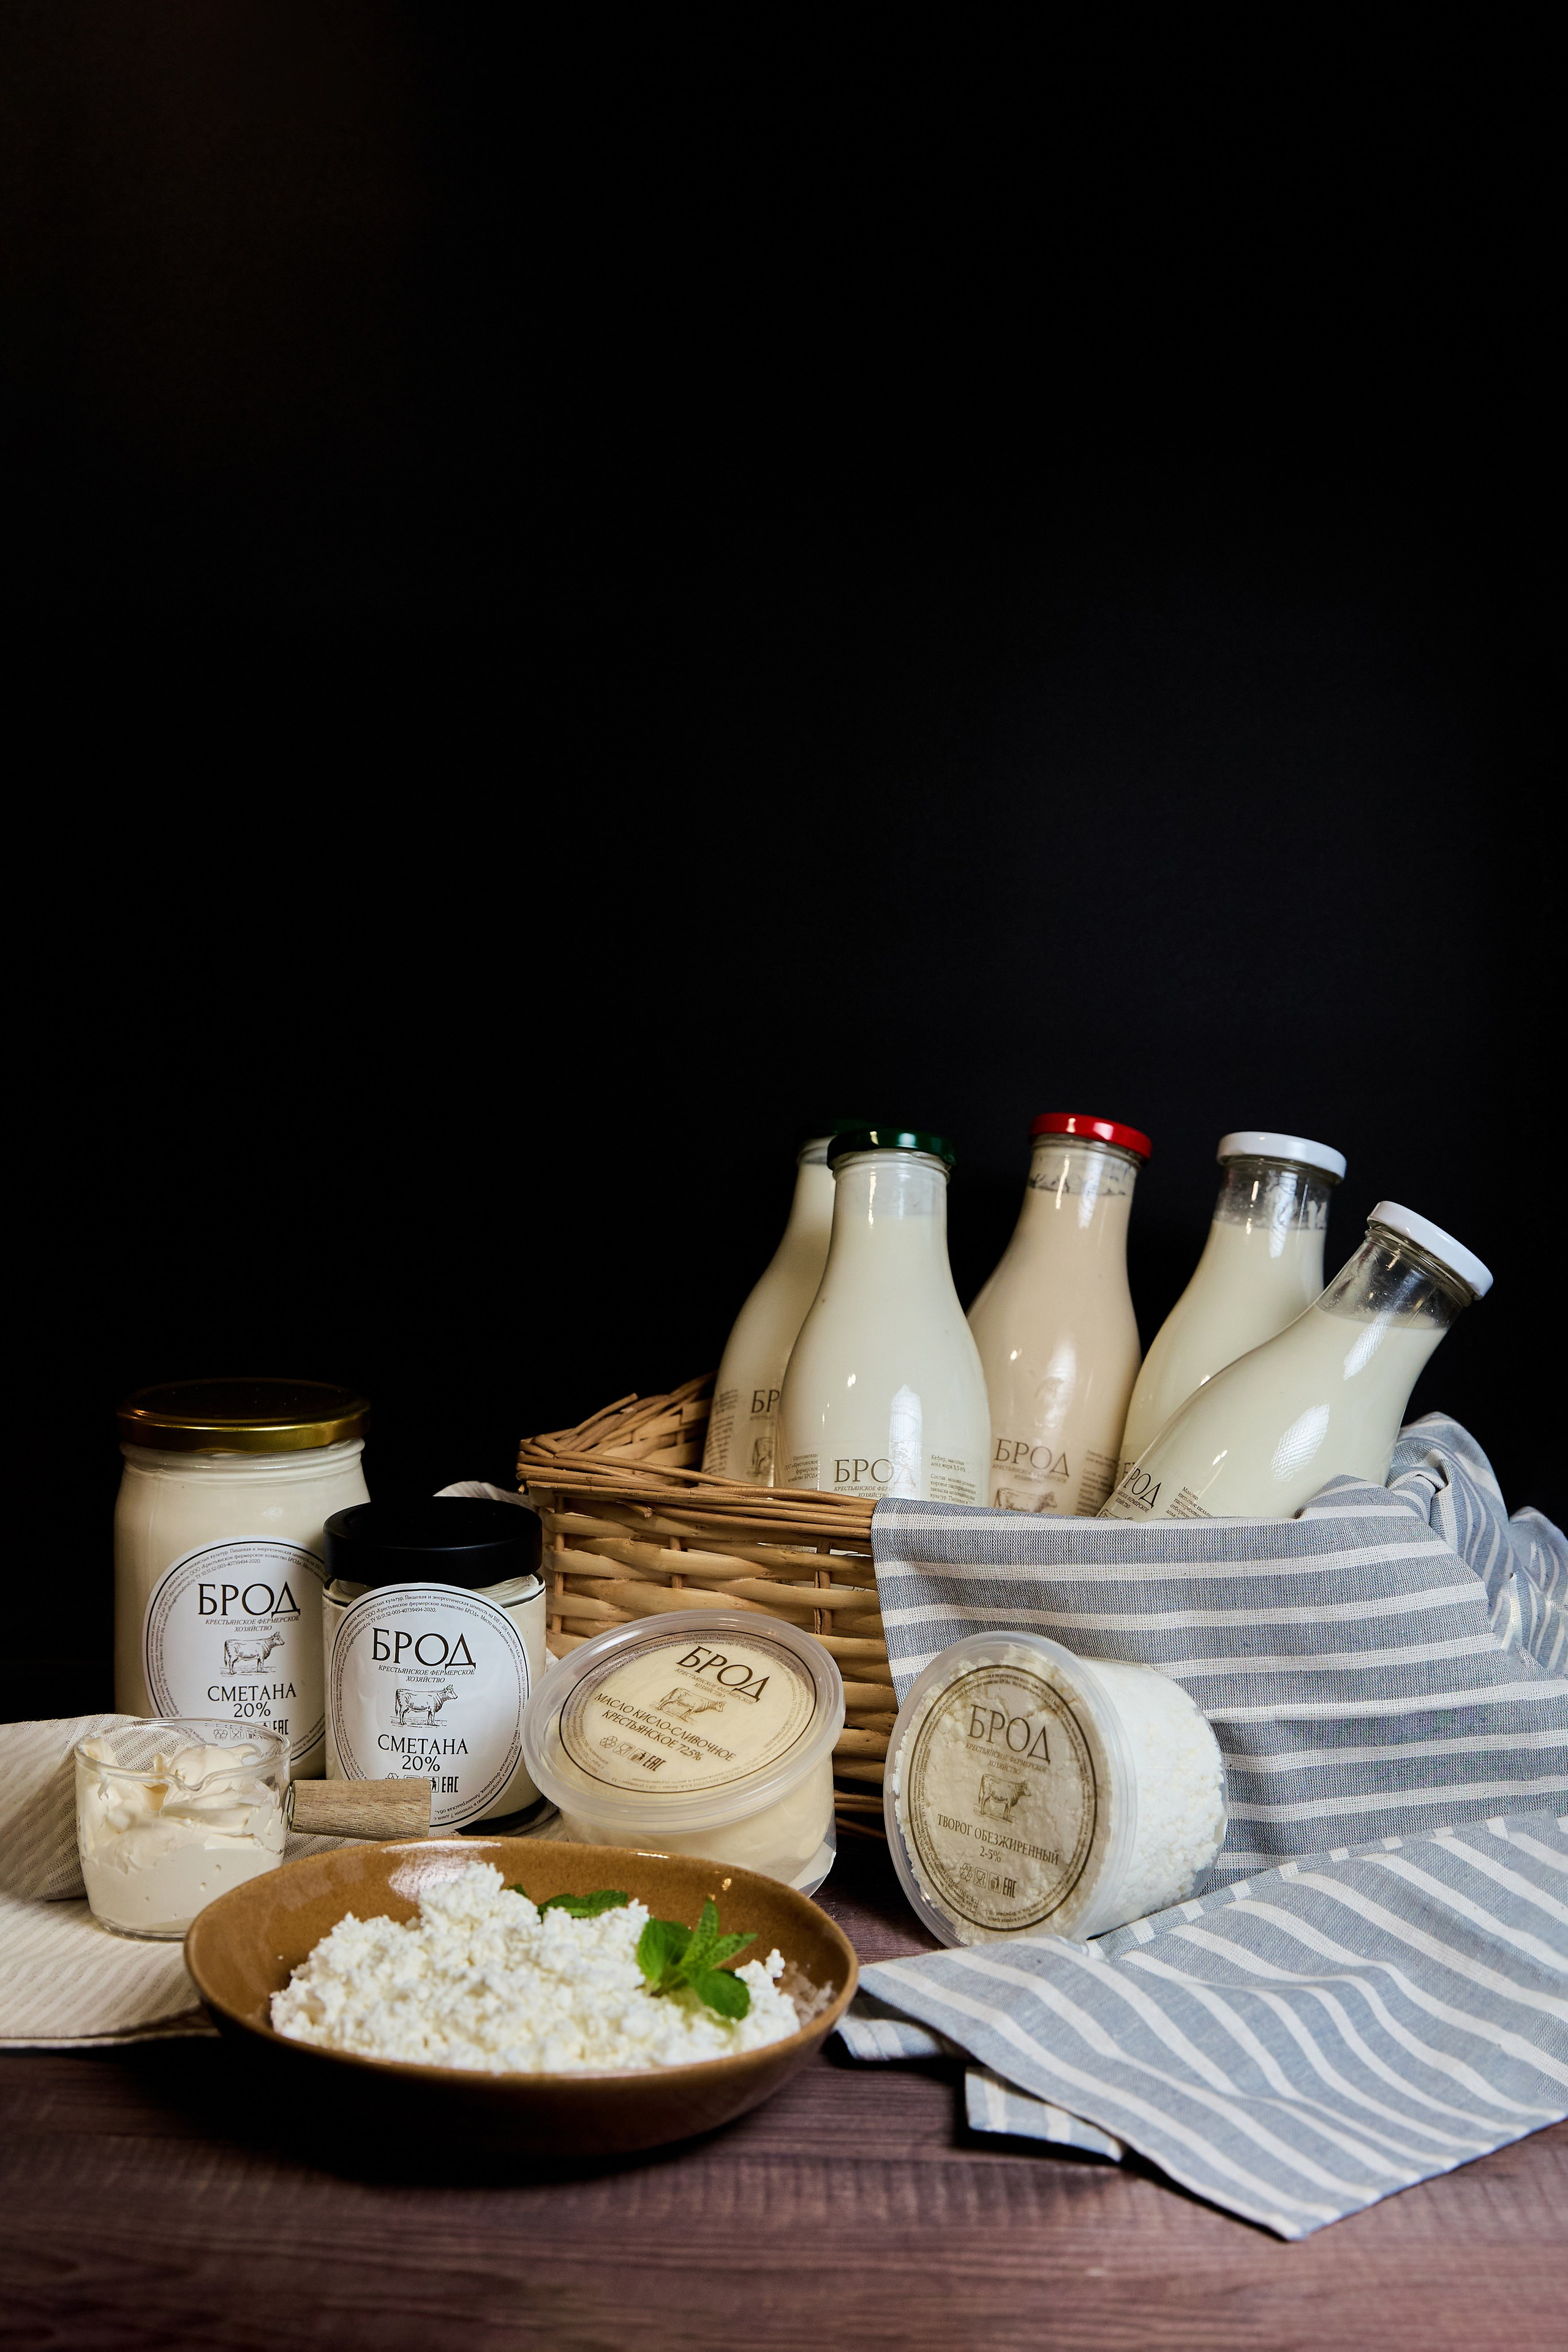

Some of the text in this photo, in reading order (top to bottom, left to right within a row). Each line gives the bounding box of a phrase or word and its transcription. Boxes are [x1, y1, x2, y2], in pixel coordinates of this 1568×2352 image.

[752, 1389, 780, 1413] БР
[993, 1439, 1069, 1477] БРОД
[834, 1459, 916, 1487] БРОД
[1123, 1468, 1162, 1509] РОД
[1182, 1487, 1199, 1500] Молоко
[1197, 1506, 1213, 1518] цельно
[198, 1581, 301, 1618] БРОД
[257, 1615, 300, 1624] ФЕРМЕРСКОЕ
[364, 1609, 377, 1620] ООО
[372, 1627, 476, 1669] БРОД
[379, 1665, 428, 1676] КРЕСТЬЯНСКОЕ
[676, 1646, 770, 1702] БРОД
[208, 1683, 296, 1702] СМЕТАНА
[675, 1668, 756, 1705] КРЕСТЬЯНСКОЕ ФЕРМЕРСКОЕ
[694, 1683, 725, 1698] ХОЗЯЙСТВО
[233, 1702, 271, 1717] 20%
[595, 1693, 634, 1713] МАСЛО
[633, 1709, 736, 1762] КИСЛО-СЛИВОЧНОЕ
[602, 1709, 678, 1748] КРЕСТЬЯНСКОЕ
[967, 1704, 1050, 1765] БРОД
[377, 1734, 469, 1755] СМЕТАНА
[402, 1755, 440, 1772] 20%
[965, 1742, 1047, 1773] КРЕСТЬЯНСКОЕ ФЕРМЕРСКОЕ
[987, 1760, 1021, 1774] ХОЗЯЙСТВО
[938, 1814, 973, 1836] ТВОРОГ
[974, 1827, 1060, 1866] ОБЕЗЖИРЕННЫЙ
[979, 1846, 1001, 1863] 2-5%
